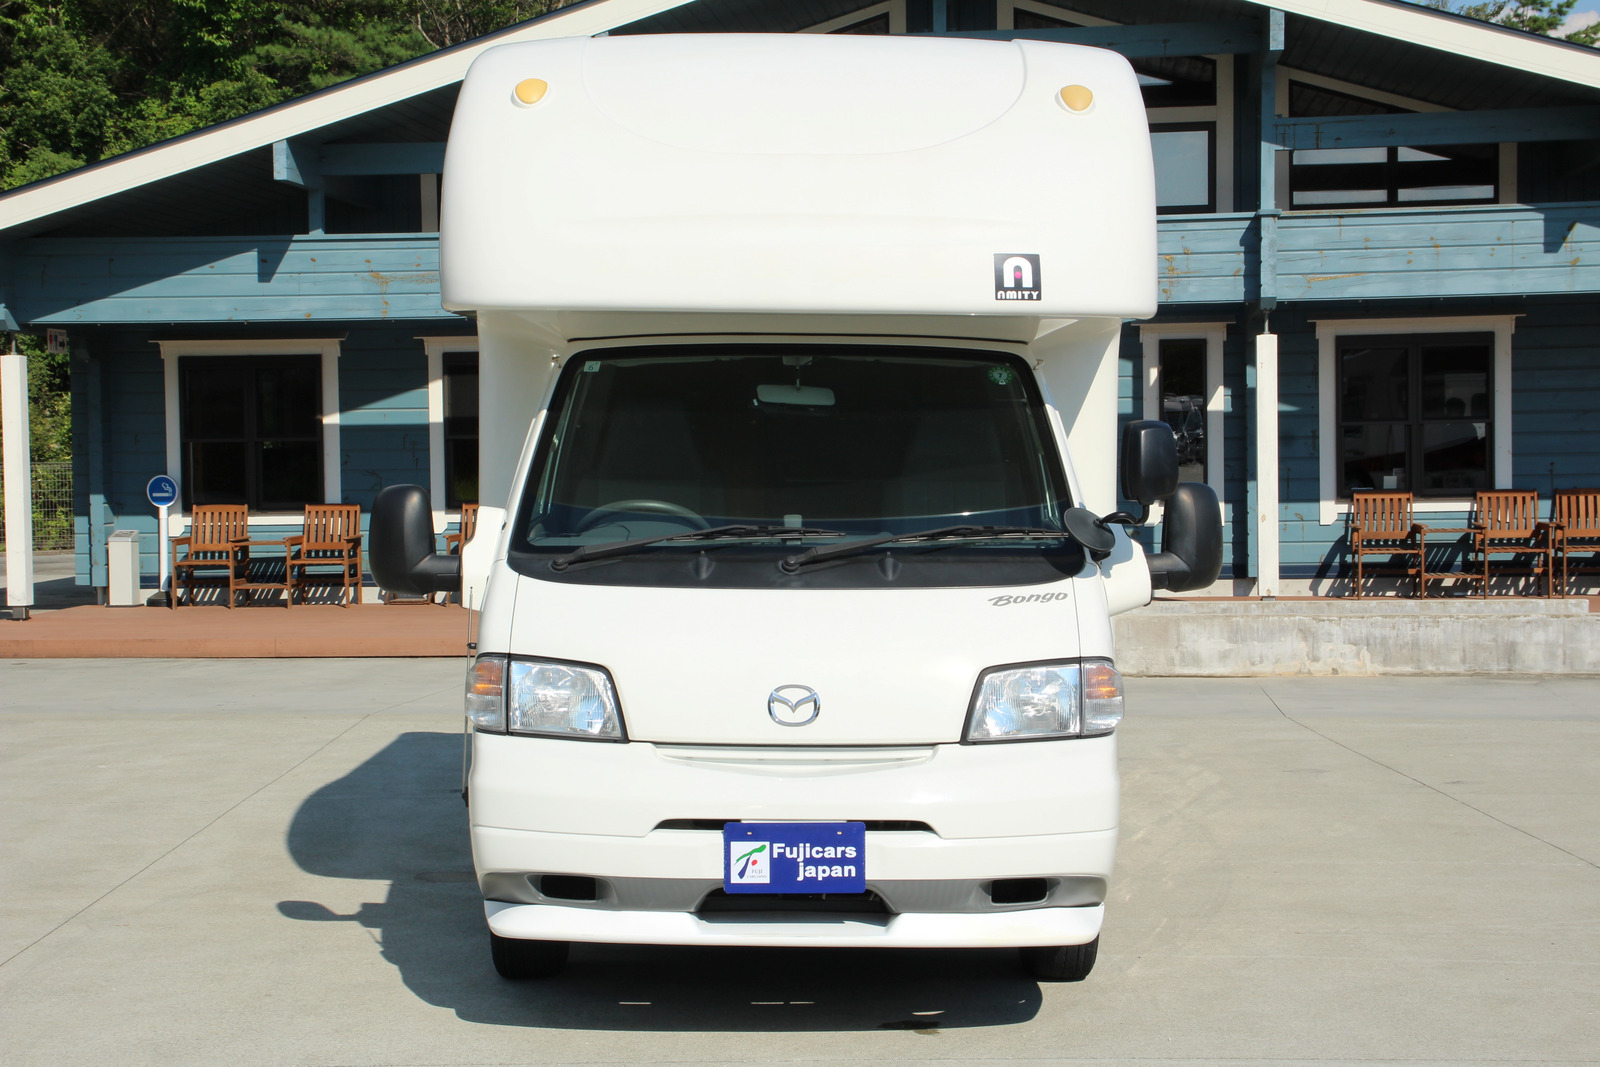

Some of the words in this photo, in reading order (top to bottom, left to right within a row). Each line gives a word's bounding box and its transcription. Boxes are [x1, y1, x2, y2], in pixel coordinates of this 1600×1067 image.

[987, 592, 1069, 607] Bongo
[772, 843, 857, 862] Fujicars
[797, 862, 857, 881] japan
